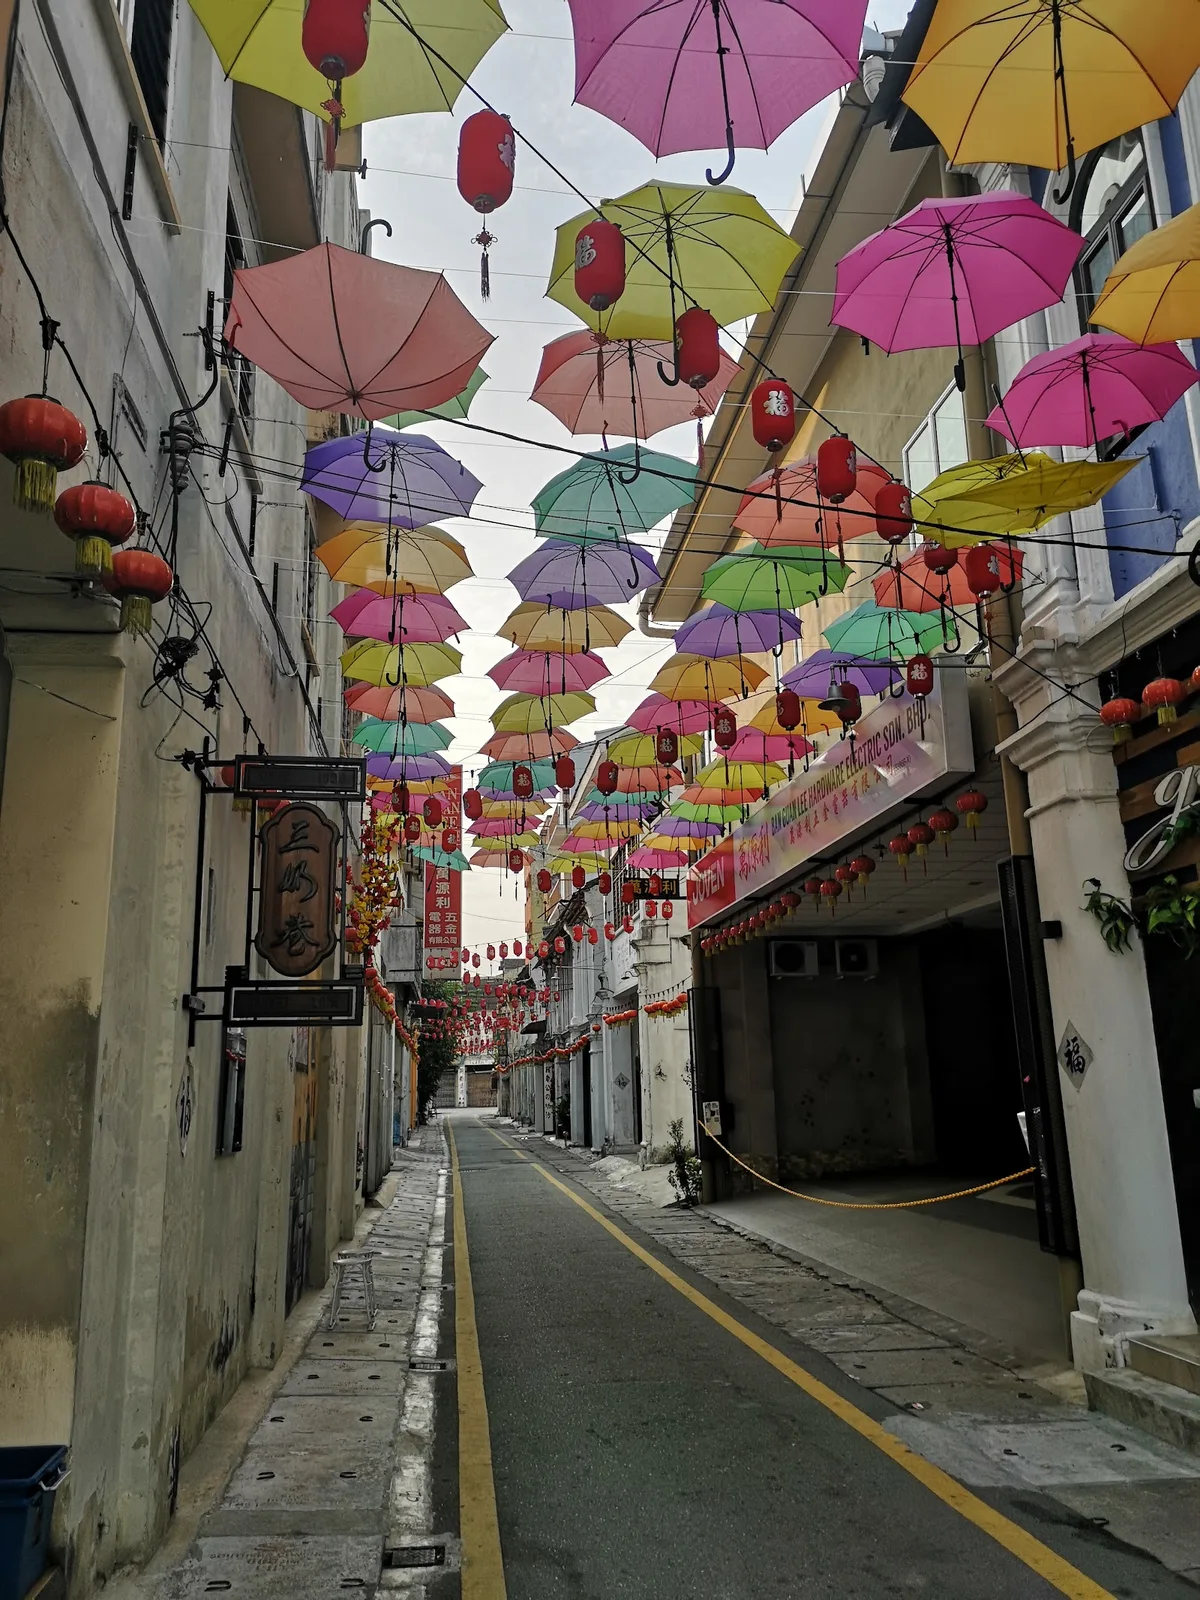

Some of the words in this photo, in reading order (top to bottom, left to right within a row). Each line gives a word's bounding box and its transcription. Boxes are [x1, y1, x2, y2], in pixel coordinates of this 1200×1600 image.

[910, 663, 928, 680] 福
[798, 792, 808, 816] LEE
[808, 760, 845, 808] HARDWARE
[846, 734, 882, 779] ELECTRIC
[884, 715, 905, 751] SDN.
[906, 699, 931, 735] BHD.
[436, 868, 450, 909] 萬源利
[628, 879, 677, 895] 萬利
[692, 856, 725, 906] JOVEN
[428, 936, 457, 945] 有限公司
[1064, 1036, 1086, 1075] 福
